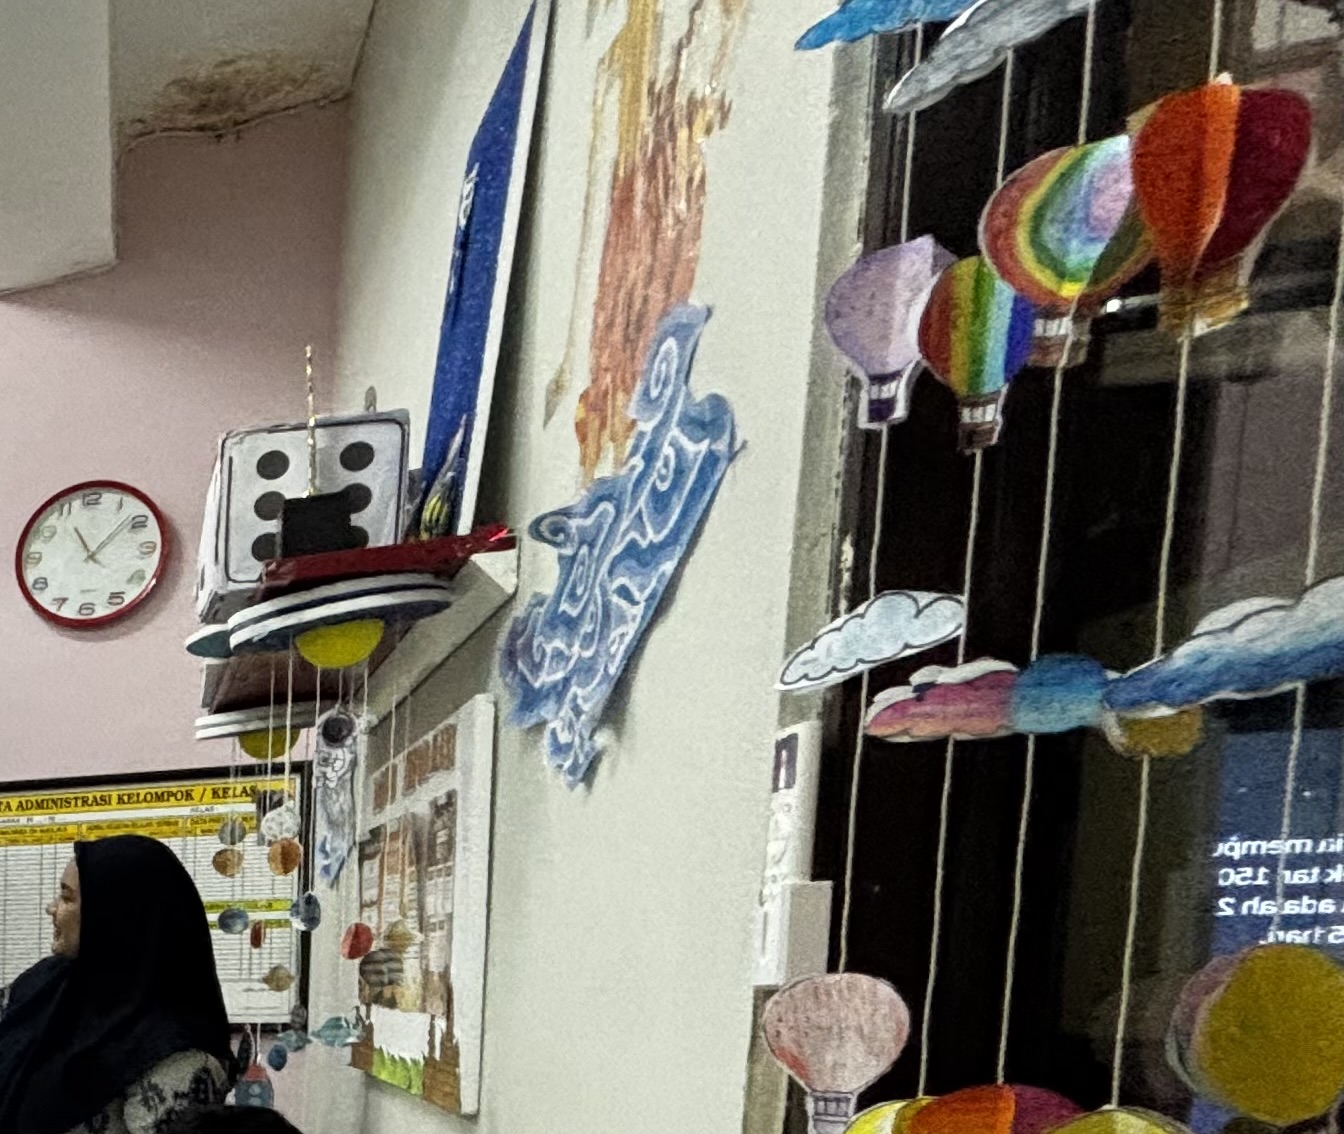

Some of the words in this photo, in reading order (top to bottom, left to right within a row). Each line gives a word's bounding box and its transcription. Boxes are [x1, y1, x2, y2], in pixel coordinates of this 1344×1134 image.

[82, 492, 102, 506] 12
[131, 514, 149, 529] 2
[32, 577, 48, 590] 8
[53, 597, 69, 611] 7
[108, 591, 125, 606] 5
[78, 602, 96, 616] 6
[15, 794, 112, 812] ADMINISTRASI
[116, 789, 194, 805] KELOMPOK
[210, 785, 257, 799] KELAS
